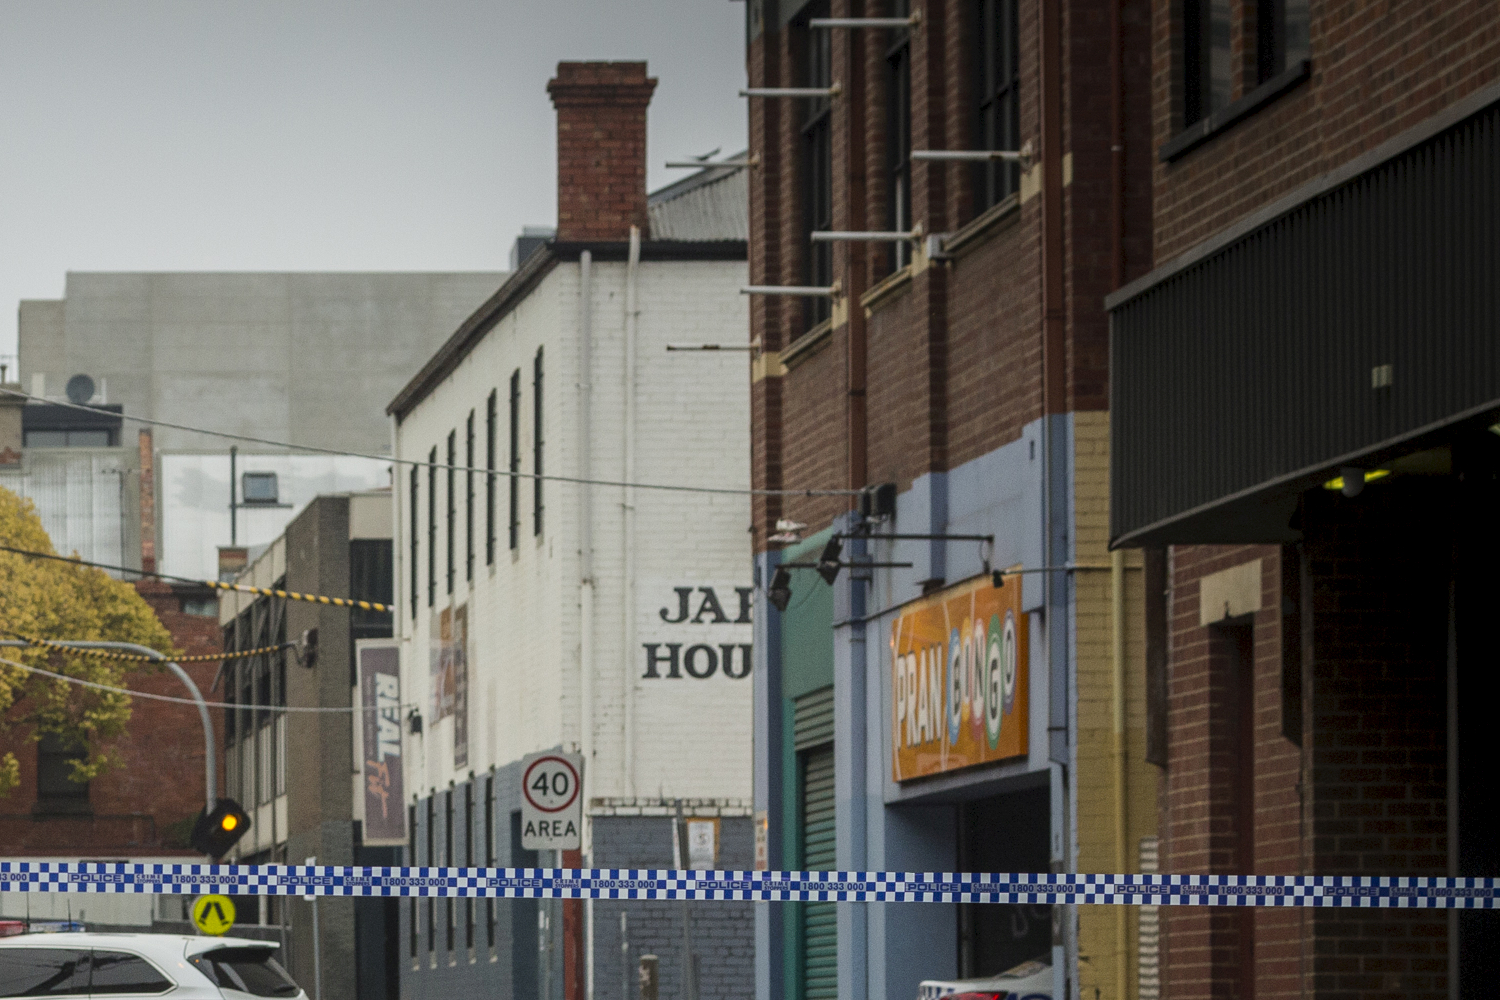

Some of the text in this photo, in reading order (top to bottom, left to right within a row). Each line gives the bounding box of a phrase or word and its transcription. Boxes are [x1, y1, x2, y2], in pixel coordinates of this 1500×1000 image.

[895, 620, 1014, 750] PRAN BINGO
[375, 672, 400, 763] REAL
[532, 771, 569, 796] 40
[524, 820, 577, 837] AREA
[10, 872, 27, 881] 000
[71, 874, 122, 883] POLICE
[174, 875, 236, 884] 1800 333 000
[280, 876, 331, 885] POLICE
[384, 878, 446, 887] 1800 333 000
[489, 879, 540, 887] POLICE
[593, 880, 655, 889] 1800 333 000
[698, 881, 749, 889] POLICE
[802, 882, 864, 891] 1800 333 000
[908, 883, 959, 892] POLICE
[1012, 884, 1073, 893] 1800 333 000
[1116, 885, 1168, 894] POLICE
[1221, 886, 1283, 895] 1800 333 000
[1326, 887, 1377, 896] POLICE
